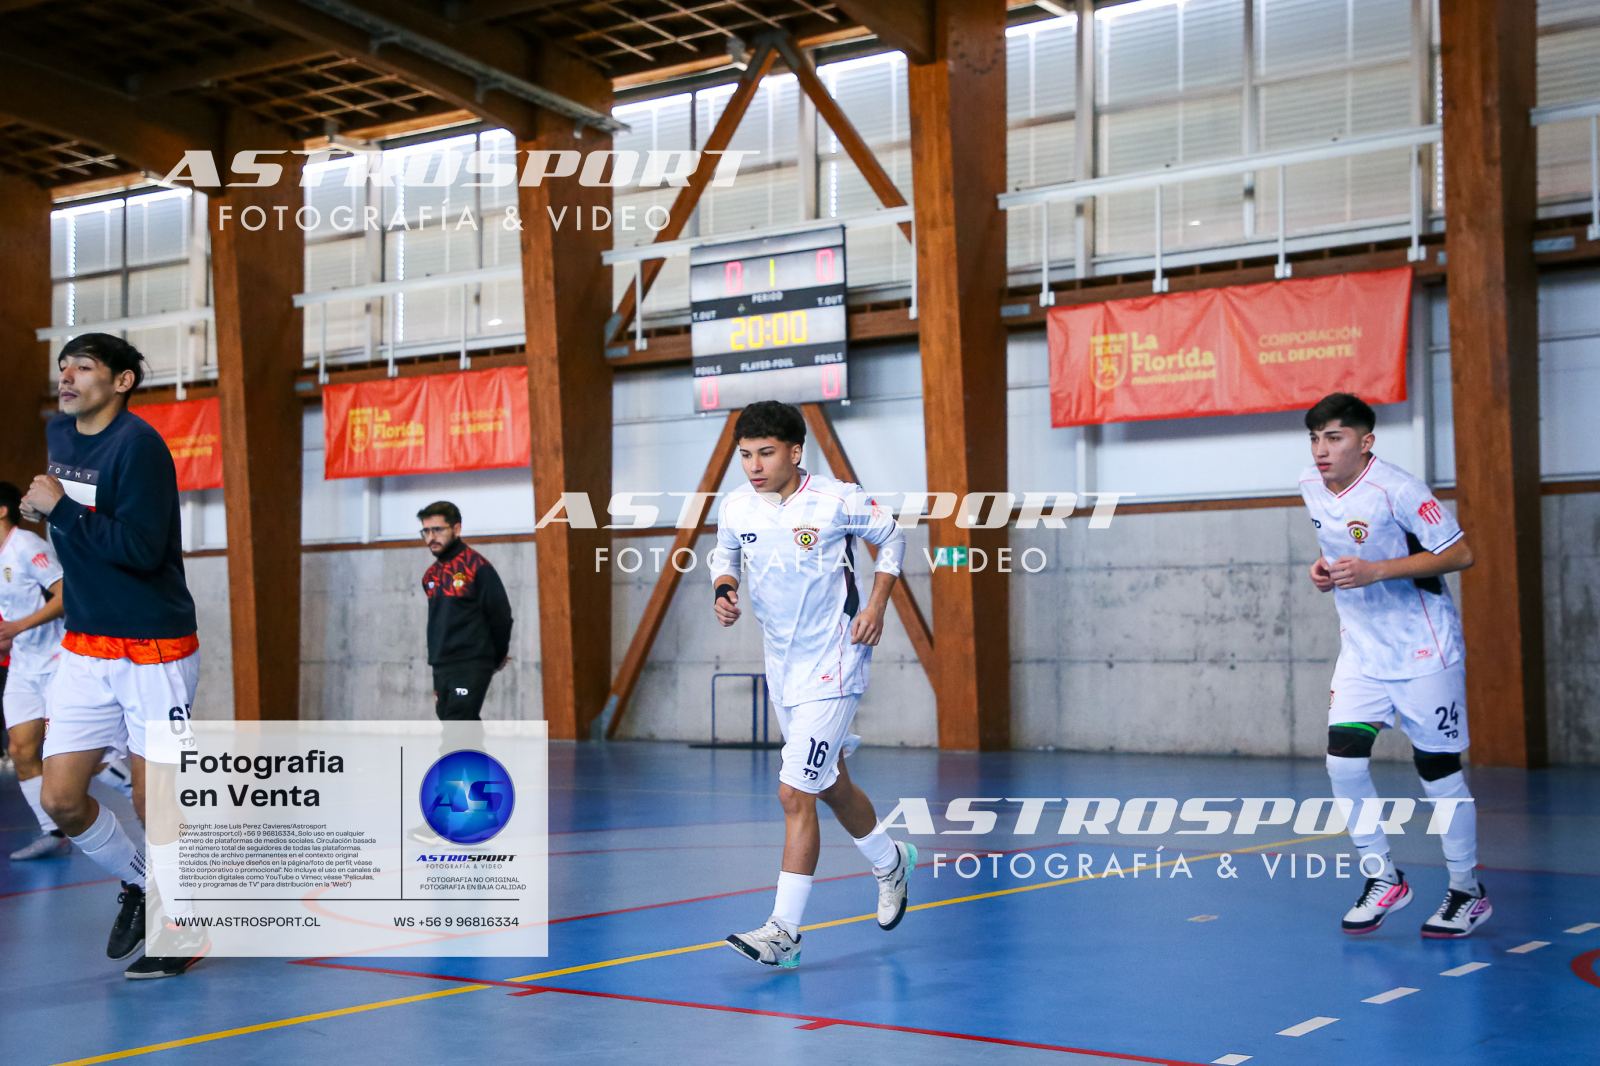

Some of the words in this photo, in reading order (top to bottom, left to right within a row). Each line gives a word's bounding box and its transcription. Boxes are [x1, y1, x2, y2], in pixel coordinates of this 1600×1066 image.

[730, 310, 808, 350] 20:00
[1260, 326, 1362, 348] CORPORACIÓN
[1131, 331, 1158, 351] La
[815, 352, 842, 363] FOULS
[1259, 351, 1284, 364] DEL
[1288, 344, 1354, 362] DEPORTE
[695, 365, 722, 376] FOULS
[374, 406, 392, 422] La
[1435, 701, 1458, 730] 24
[806, 736, 829, 768] 16
